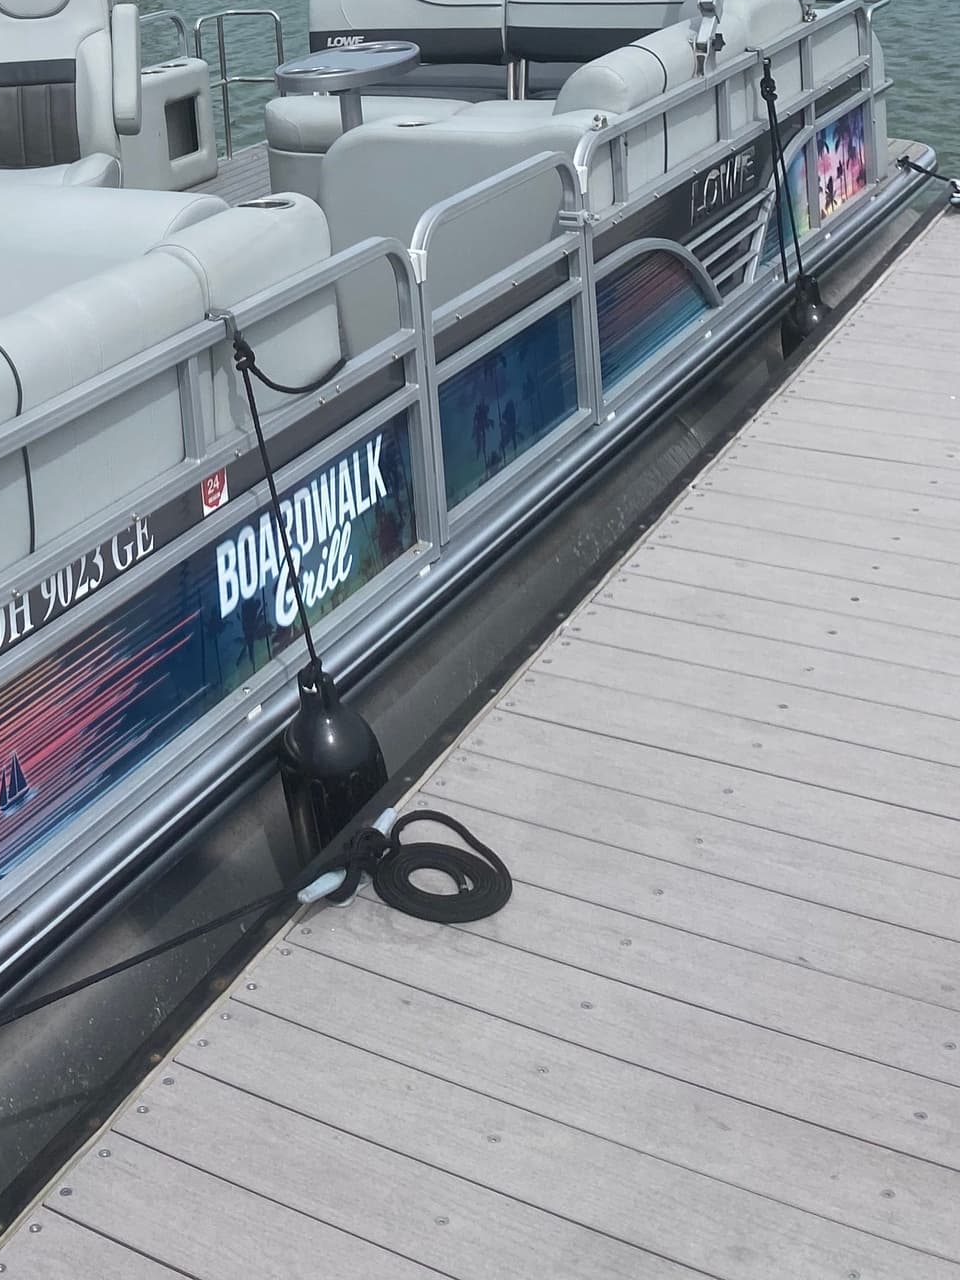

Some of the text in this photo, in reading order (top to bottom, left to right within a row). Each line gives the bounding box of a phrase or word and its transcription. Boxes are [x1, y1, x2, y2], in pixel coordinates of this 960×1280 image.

[327, 36, 365, 48] LOWE
[690, 145, 756, 227] LOWE
[207, 474, 220, 496] 24
[216, 433, 388, 619] BOARDWALK
[40, 543, 104, 622] 9023
[111, 516, 155, 571] GE
[275, 521, 353, 628] Grill
